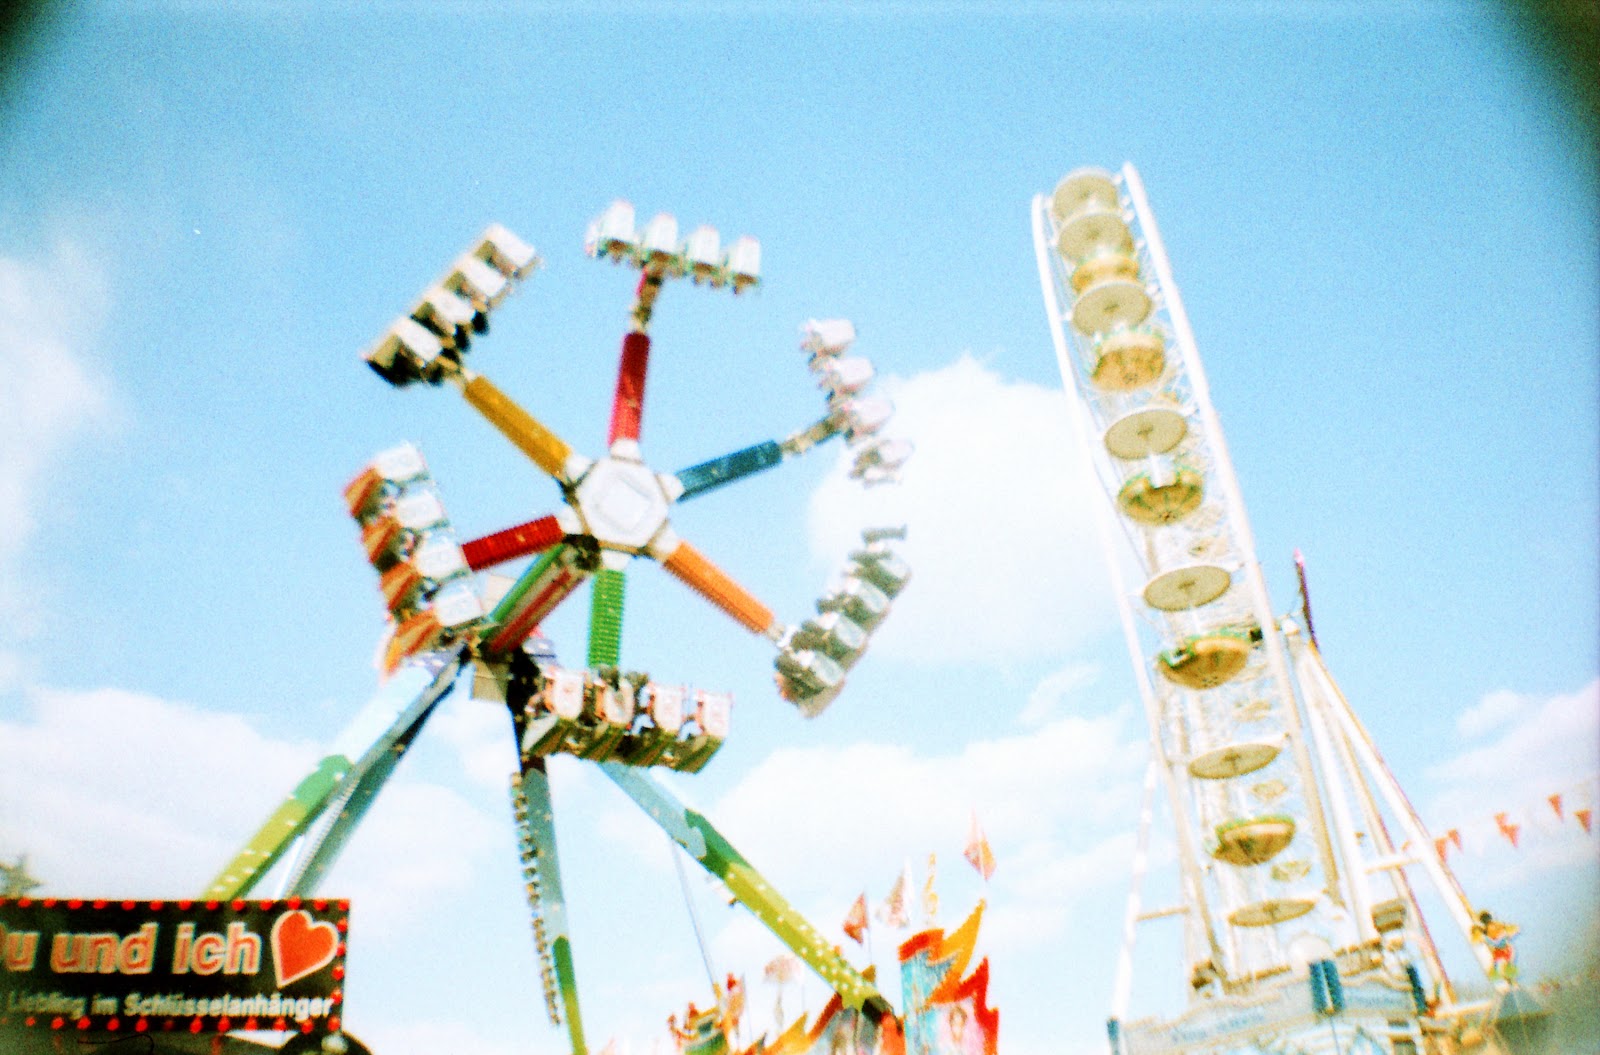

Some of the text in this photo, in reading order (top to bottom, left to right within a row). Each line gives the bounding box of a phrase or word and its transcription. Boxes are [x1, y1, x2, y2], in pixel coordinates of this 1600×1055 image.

[50, 921, 159, 975] und
[171, 921, 263, 976] ich
[91, 993, 118, 1015] im
[123, 991, 334, 1022] Schlüsselanhänger
